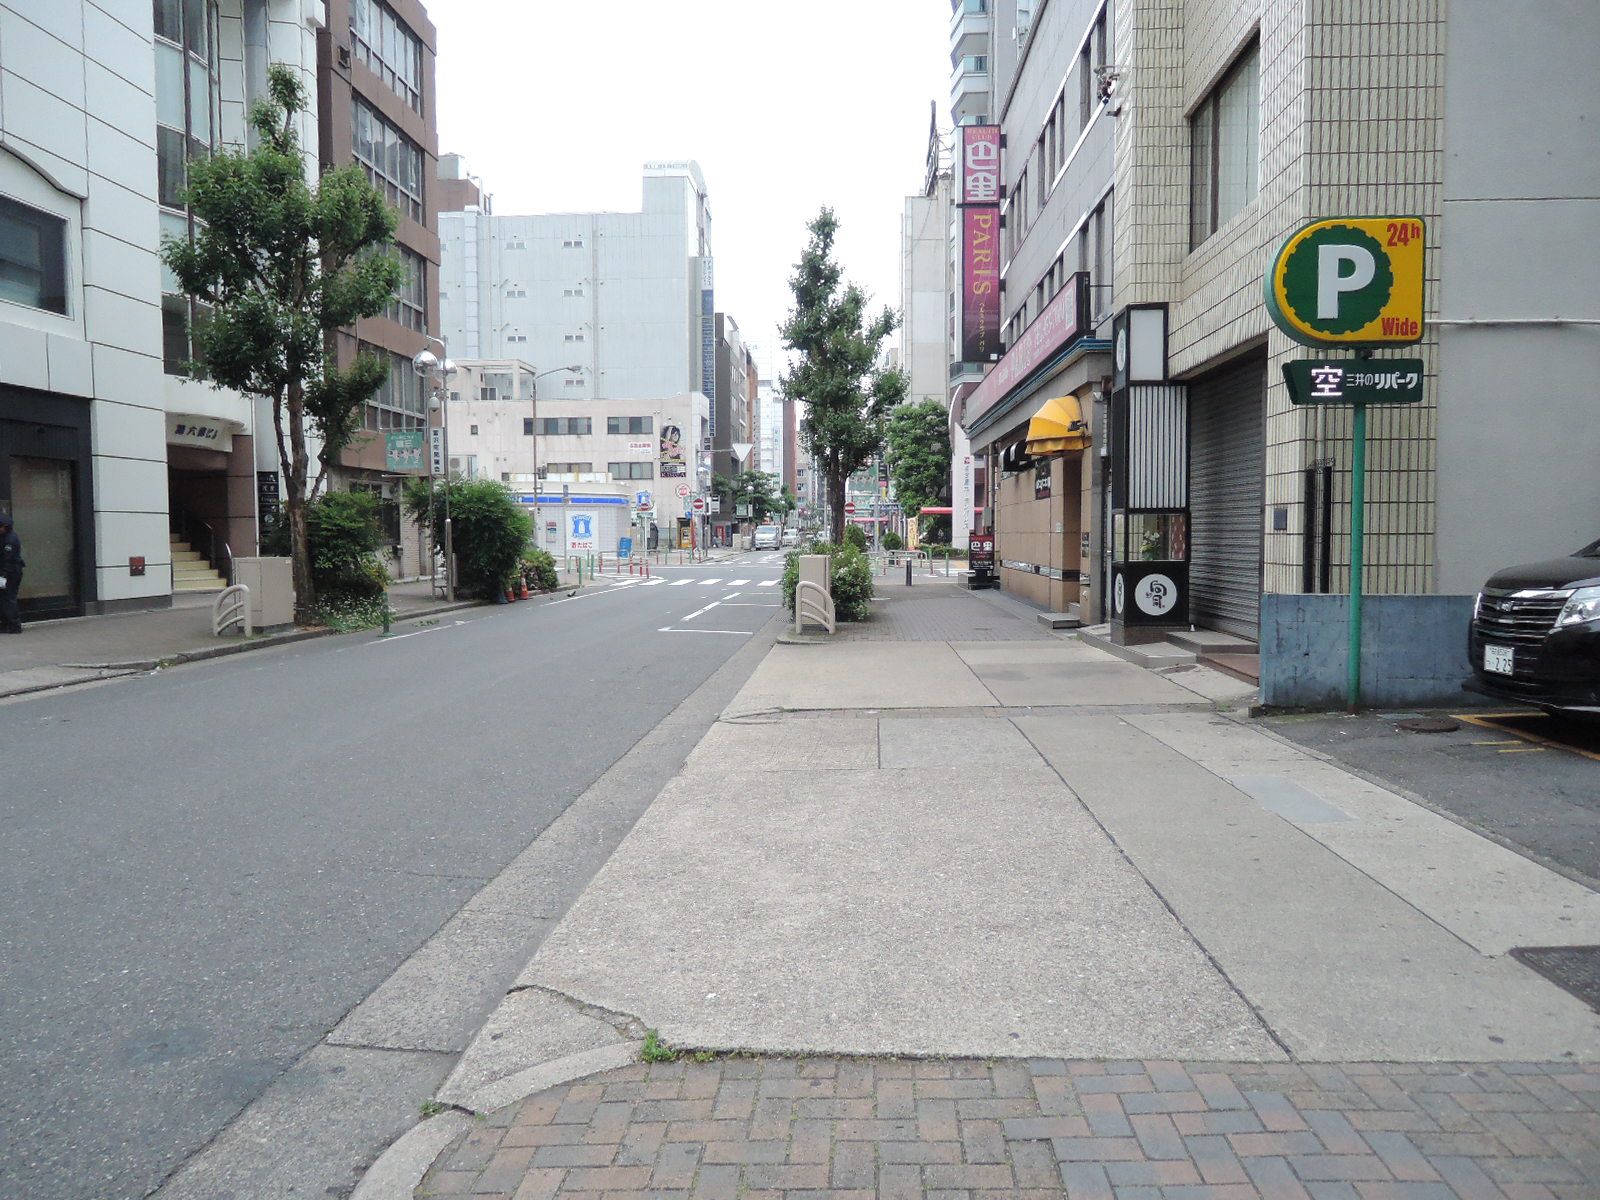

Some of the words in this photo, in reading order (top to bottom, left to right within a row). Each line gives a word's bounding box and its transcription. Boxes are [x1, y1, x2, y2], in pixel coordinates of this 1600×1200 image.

[1387, 223, 1420, 247] 24h
[973, 214, 993, 295] PARIS
[1317, 244, 1376, 319] P
[1382, 317, 1418, 336] Wide
[1311, 366, 1342, 396] 空
[1346, 371, 1418, 390] 三井のリパーク
